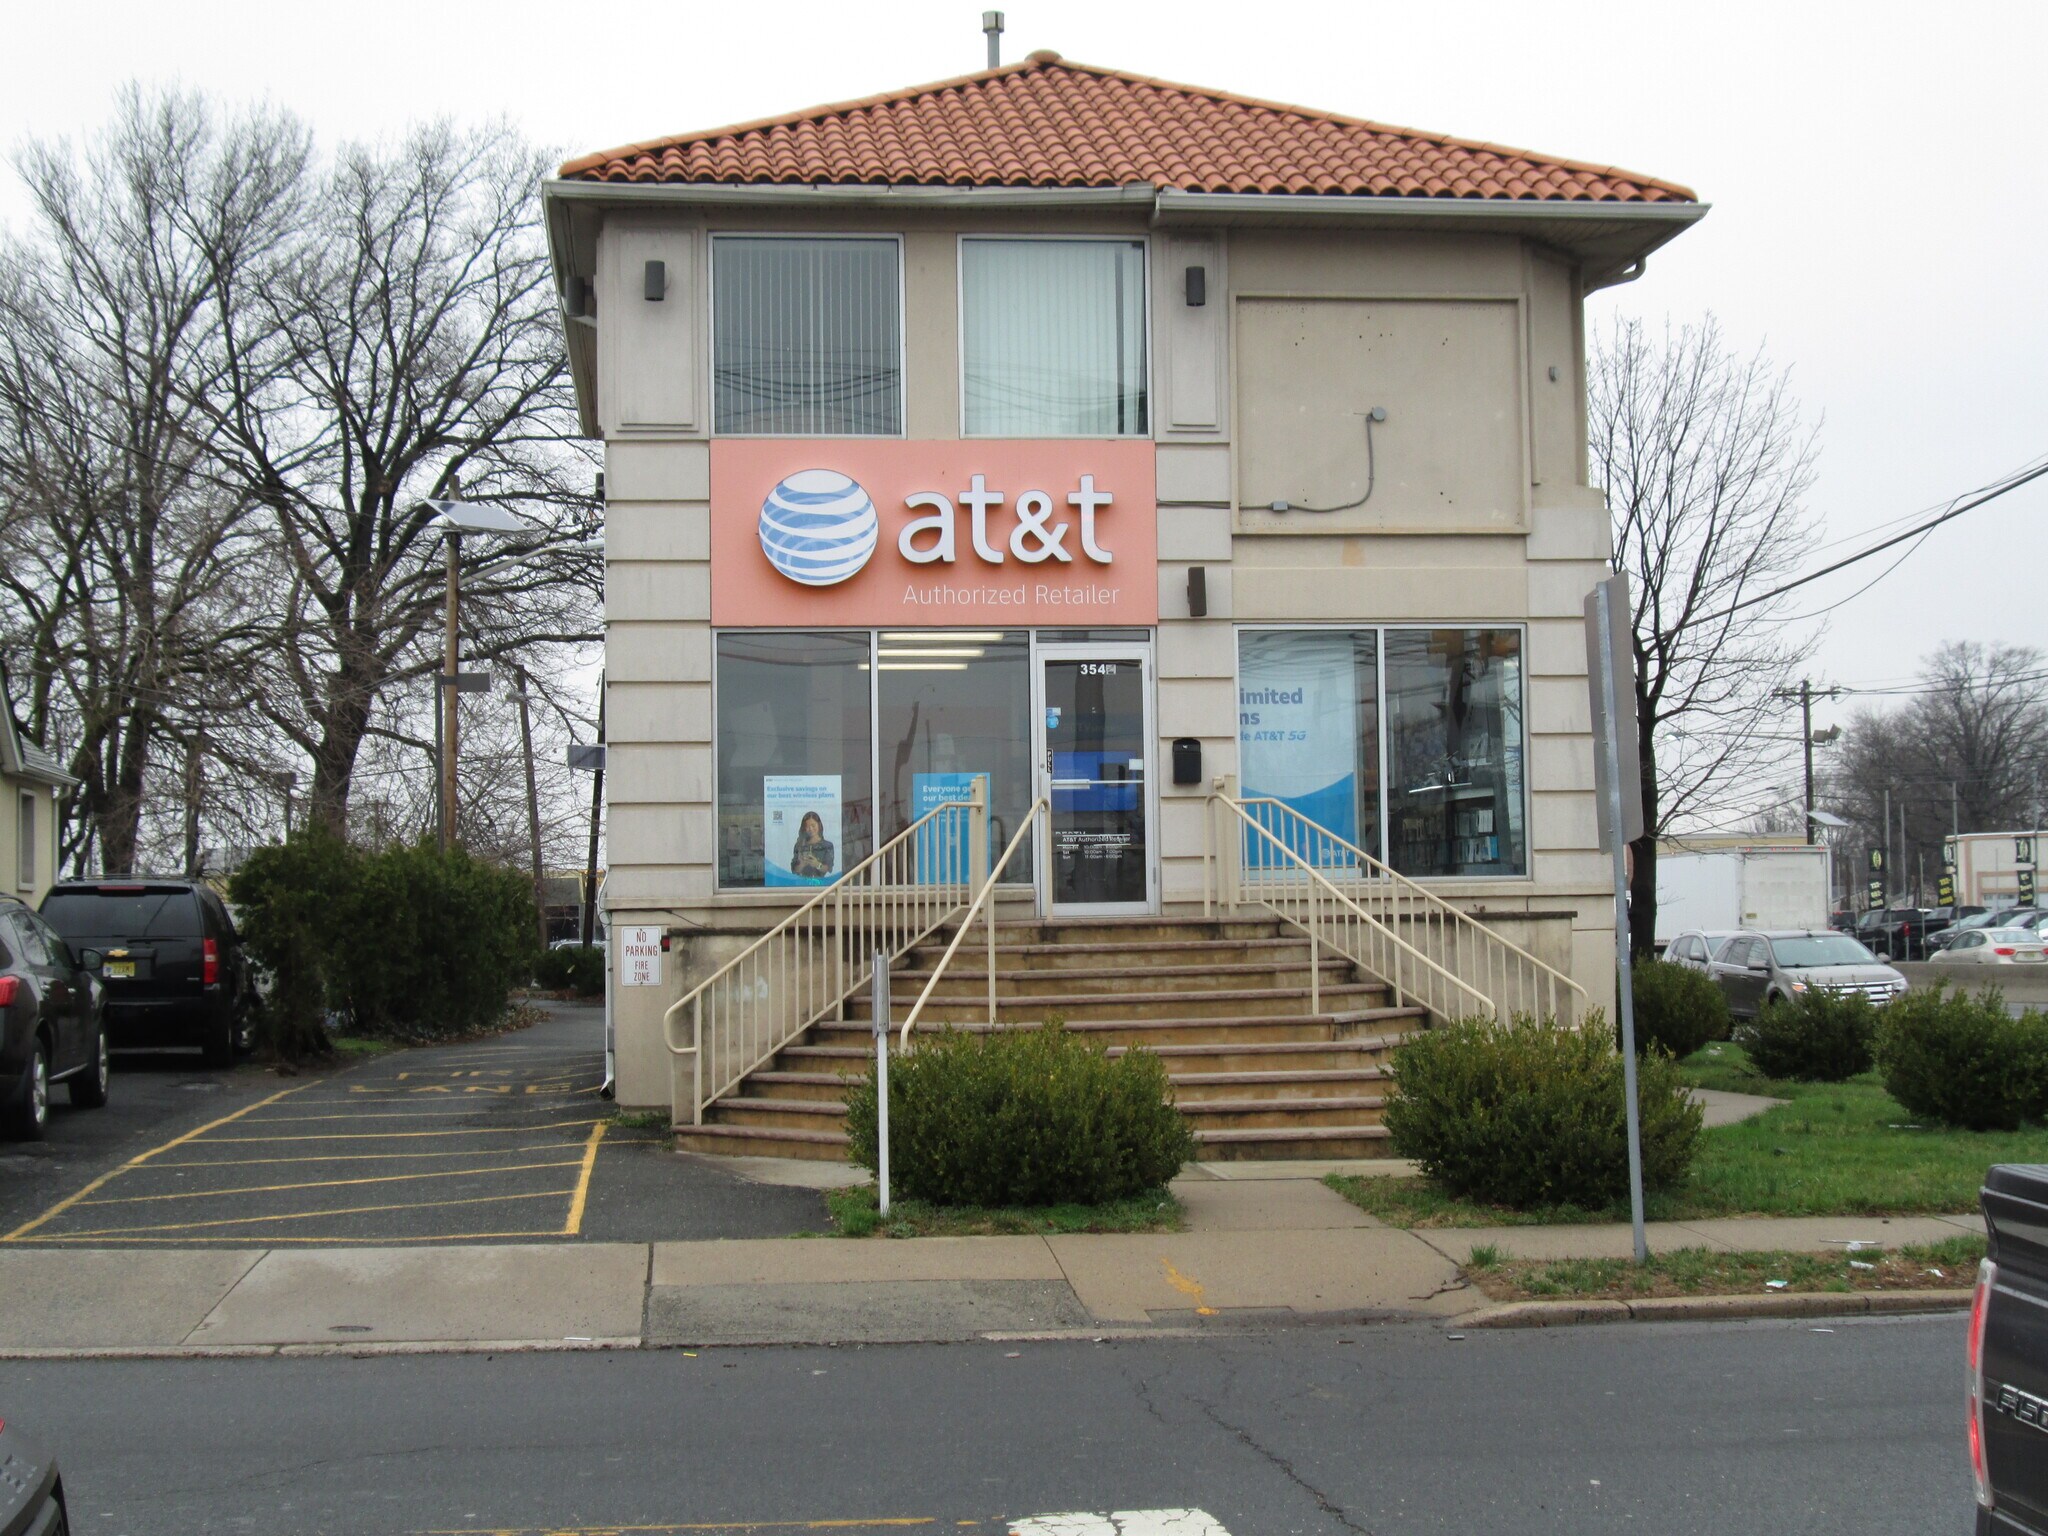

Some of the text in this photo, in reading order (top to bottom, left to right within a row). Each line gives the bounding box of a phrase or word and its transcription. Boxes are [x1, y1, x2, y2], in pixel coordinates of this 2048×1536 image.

[897, 473, 1114, 565] at&t
[902, 584, 1120, 605] Authorized Retailer
[1080, 663, 1106, 676] 354
[1254, 731, 1285, 741] AT&T
[796, 785, 818, 793] savings
[923, 785, 961, 794] Everyone
[938, 793, 957, 802] best
[636, 931, 647, 943] NO
[625, 945, 658, 957] PARKING
[634, 960, 648, 970] FIRE
[633, 972, 650, 982] ZONE
[348, 1082, 573, 1095] LANE
